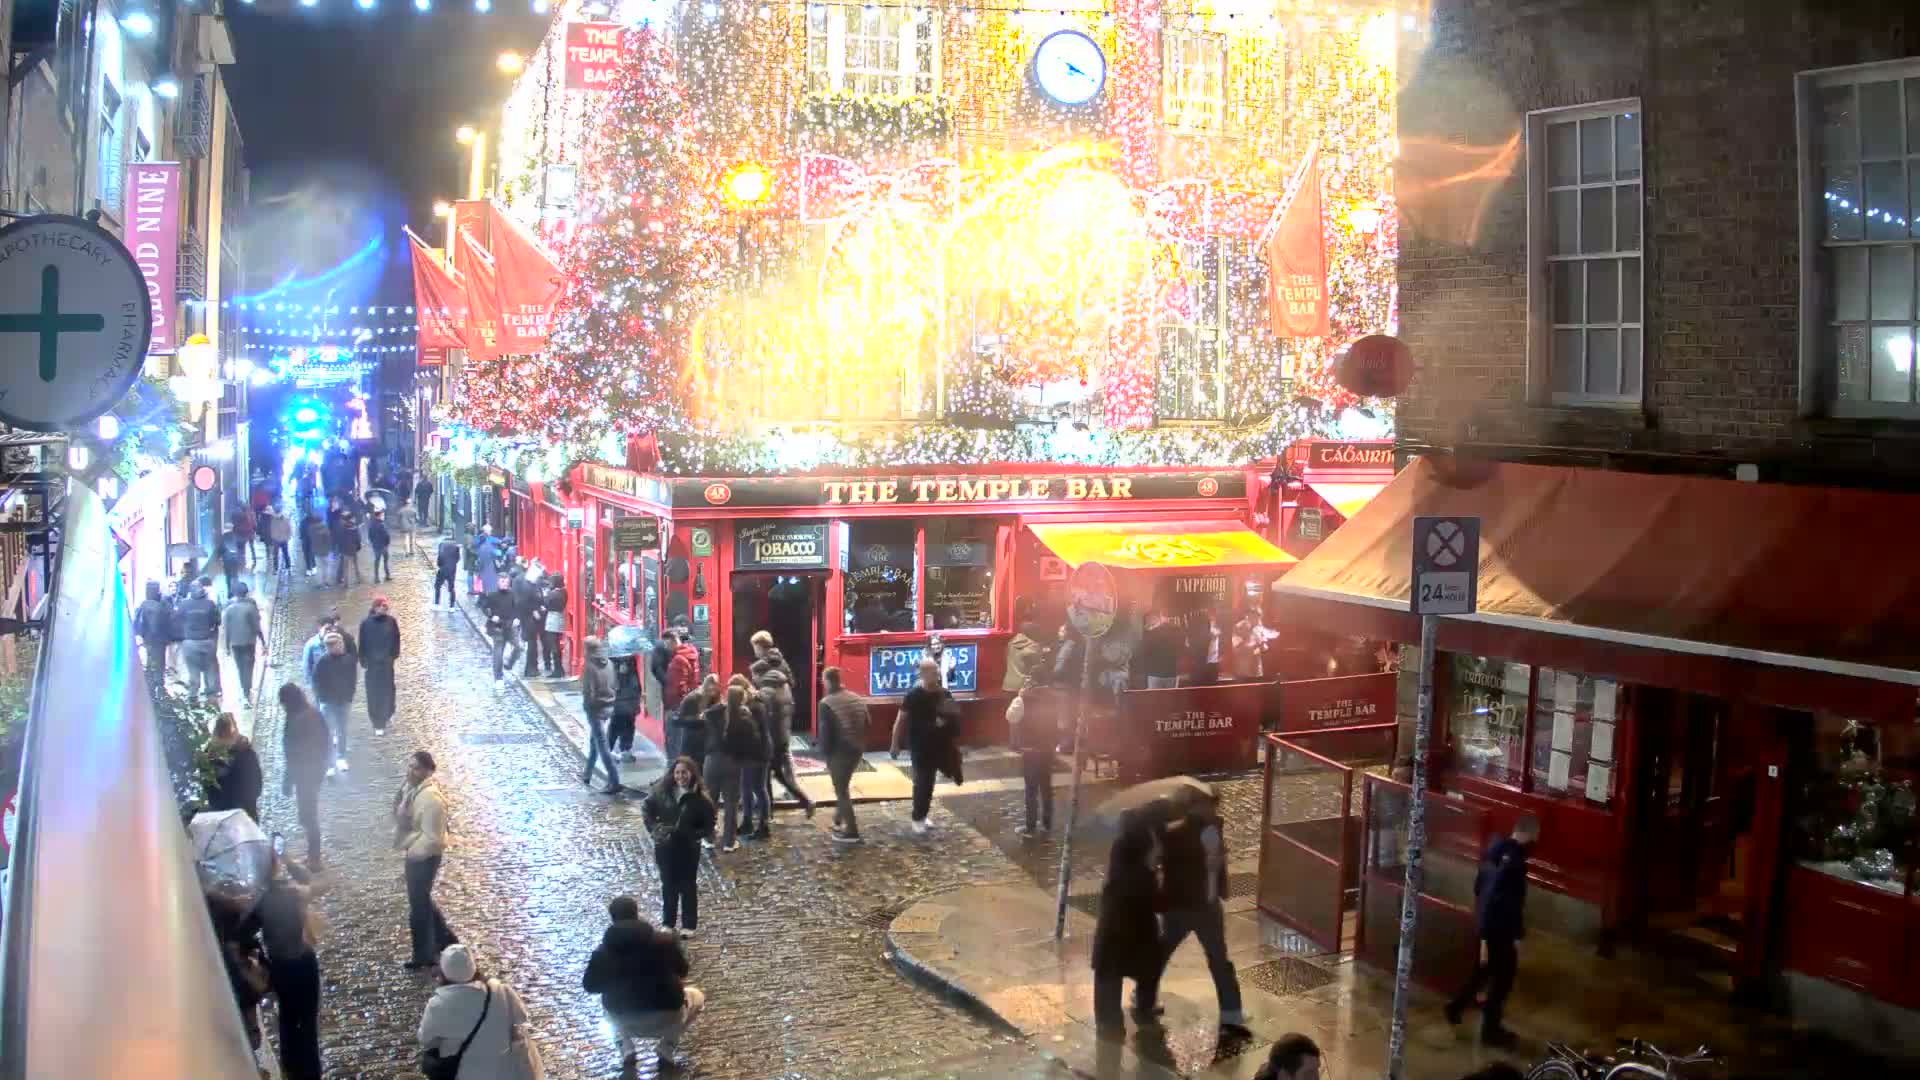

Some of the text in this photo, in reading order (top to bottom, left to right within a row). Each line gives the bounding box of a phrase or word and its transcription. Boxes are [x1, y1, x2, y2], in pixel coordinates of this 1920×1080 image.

[584, 28, 618, 45] THE
[136, 170, 168, 232] NINE
[1289, 302, 1316, 315] BAR
[516, 327, 547, 337] BAR
[823, 477, 1133, 504] THE TEMPLE BAR
[748, 539, 816, 562] TOBACCO
[1176, 579, 1226, 597] EMPEROR
[1422, 584, 1444, 602] 24
[1186, 711, 1205, 719] THE
[1308, 703, 1376, 721] TEMPLE BAR
[1154, 716, 1233, 732] TEMPLE BAR
